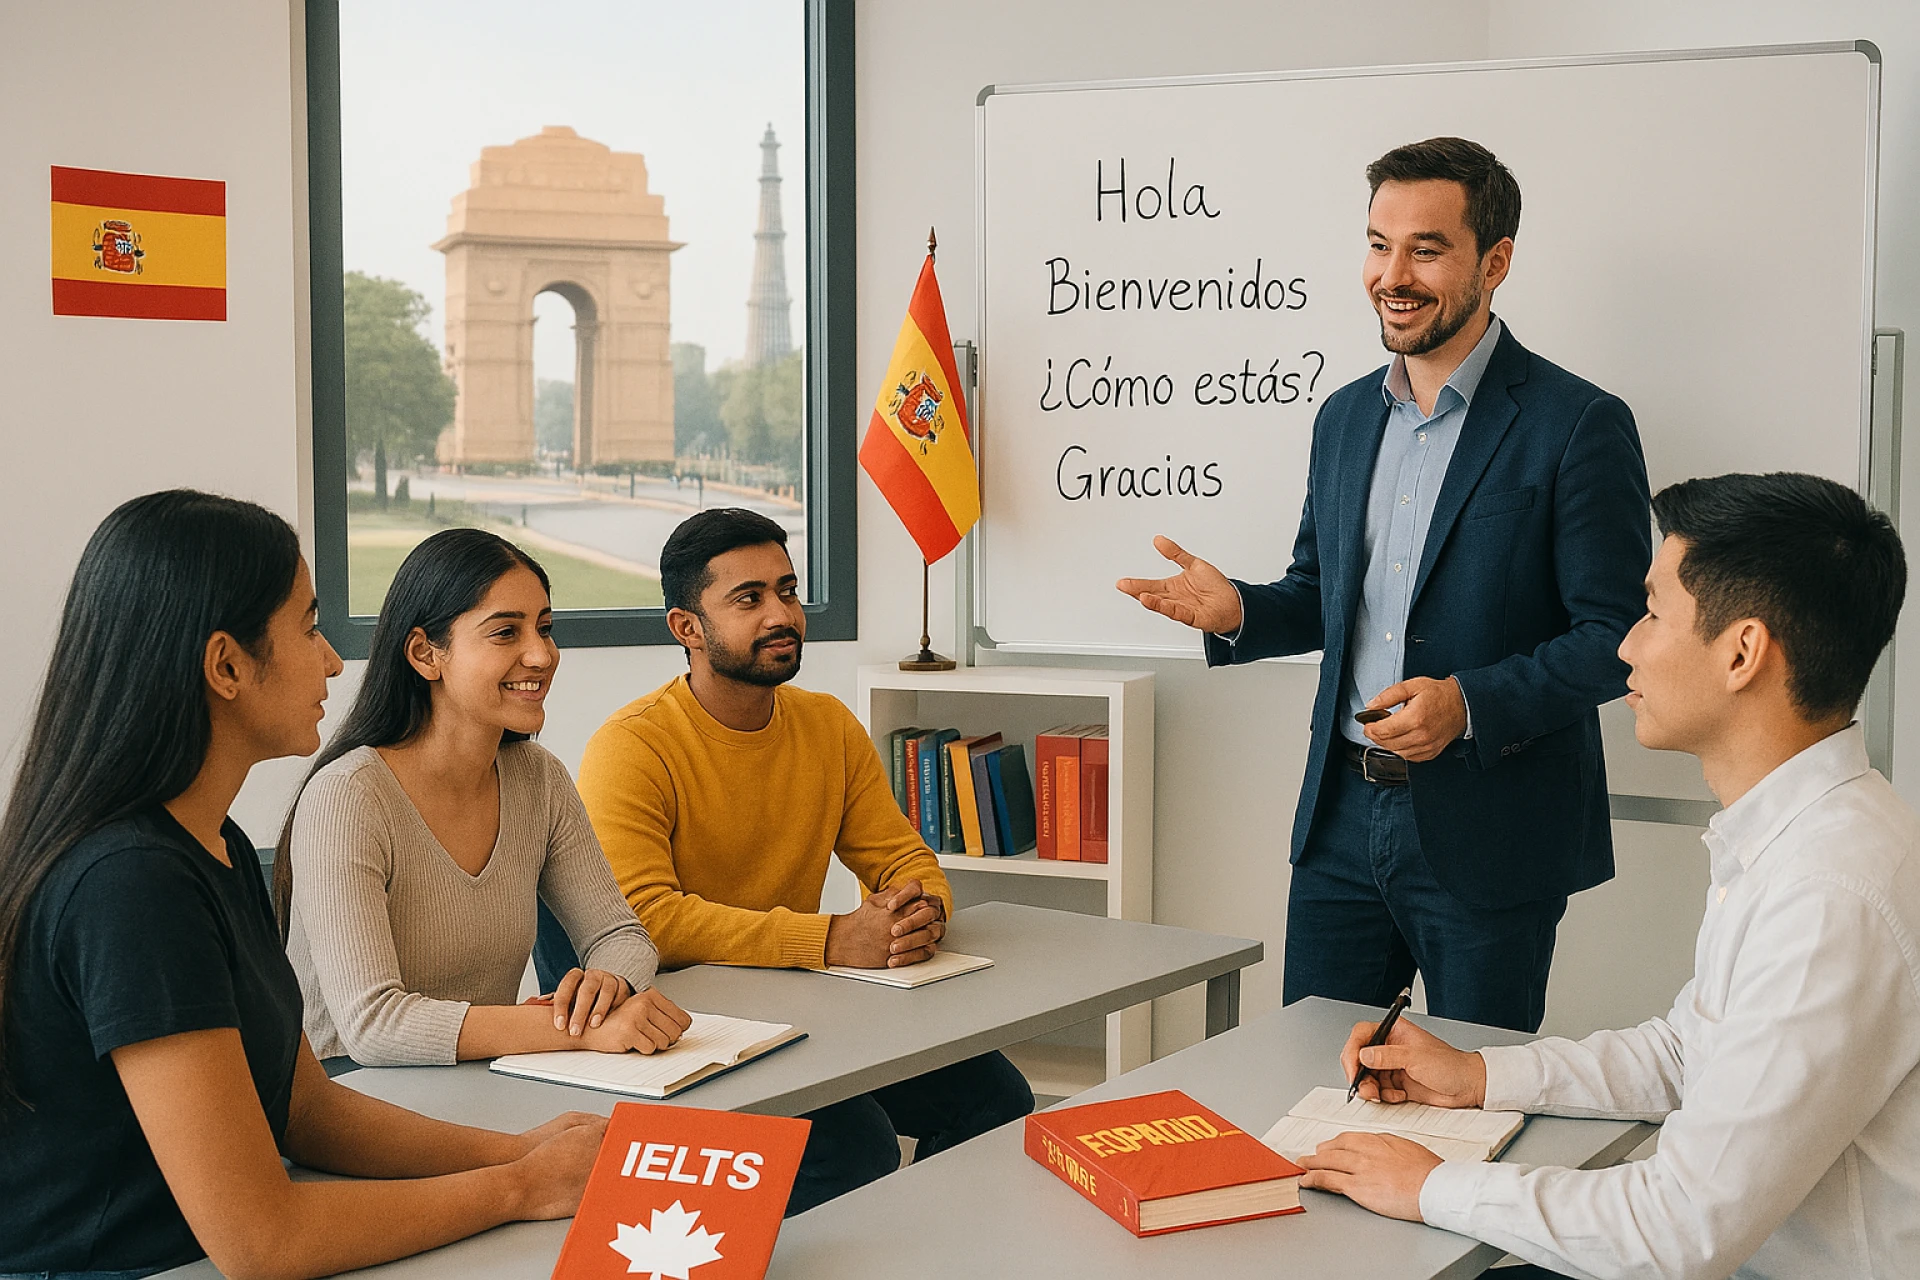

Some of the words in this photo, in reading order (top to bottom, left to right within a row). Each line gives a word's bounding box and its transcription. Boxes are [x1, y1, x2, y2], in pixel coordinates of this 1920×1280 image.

[1097, 157, 1221, 223] Hola
[1045, 257, 1308, 316] Bienvenidos
[1039, 355, 1174, 412] ¿Cómo
[1194, 350, 1325, 406] estás?
[1056, 445, 1223, 501] Gracias
[620, 1141, 764, 1190] IELTS
